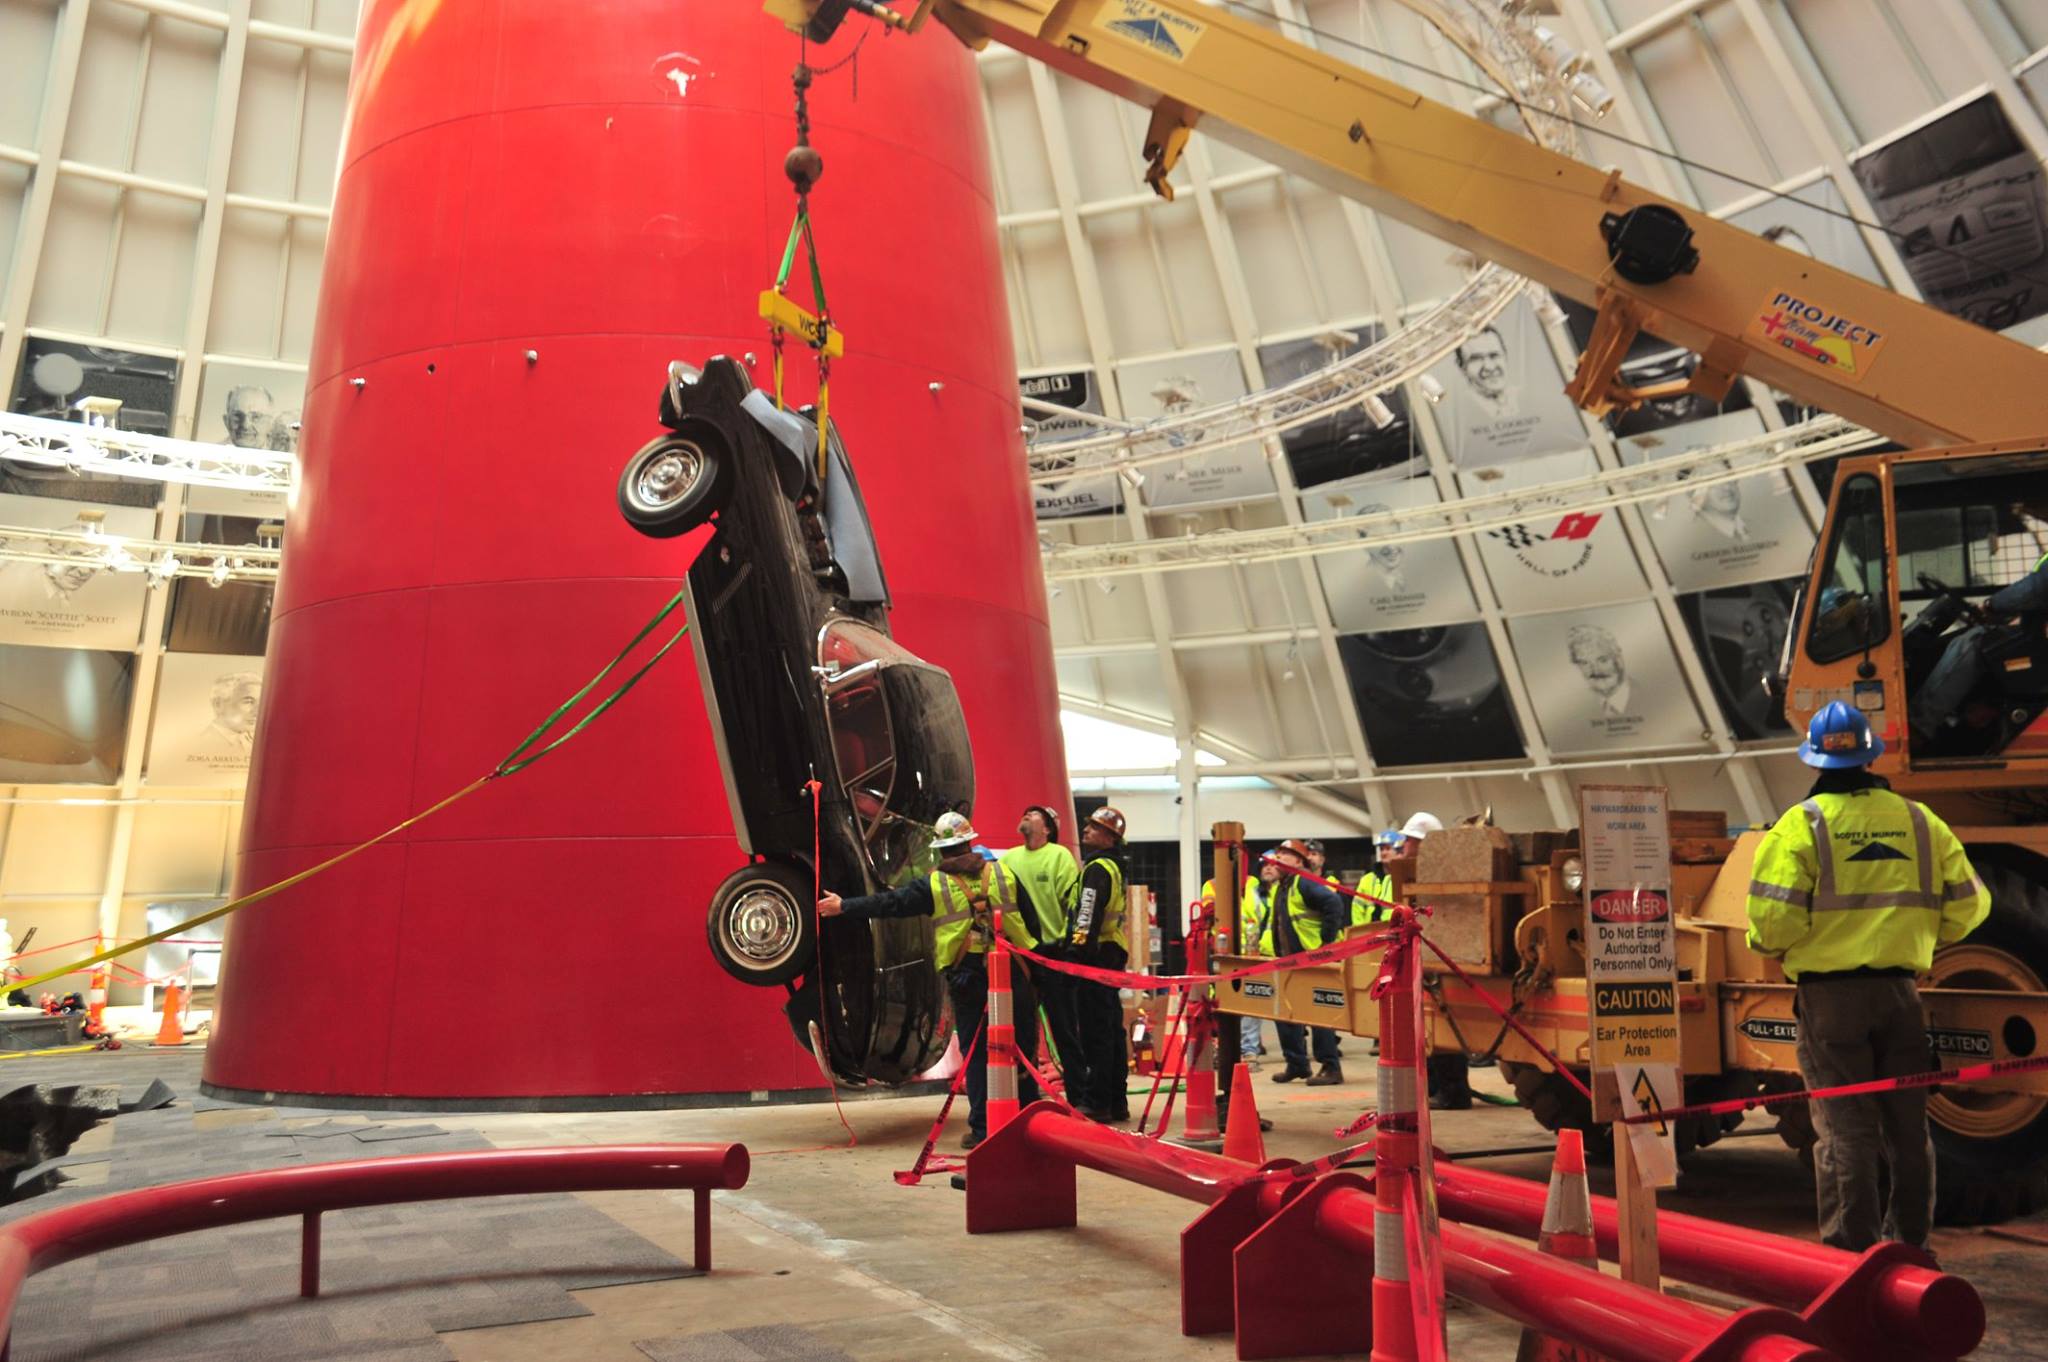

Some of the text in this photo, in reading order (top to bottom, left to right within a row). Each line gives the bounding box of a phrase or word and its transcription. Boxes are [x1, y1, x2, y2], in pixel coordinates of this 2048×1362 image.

[1773, 292, 1881, 347] PROJECT
[1600, 898, 1661, 916] DANGER
[1599, 926, 1665, 941] Do Not Enter
[1604, 941, 1661, 956] Authorized
[1593, 954, 1673, 972] Personnel Only
[1597, 988, 1674, 1009] CAUTION
[1597, 1024, 1677, 1041] Ear Protection
[1747, 1022, 1797, 1038] FULL-EXTE
[1624, 1043, 1651, 1057] Area
[1925, 1032, 1990, 1053] D-EXTEND
